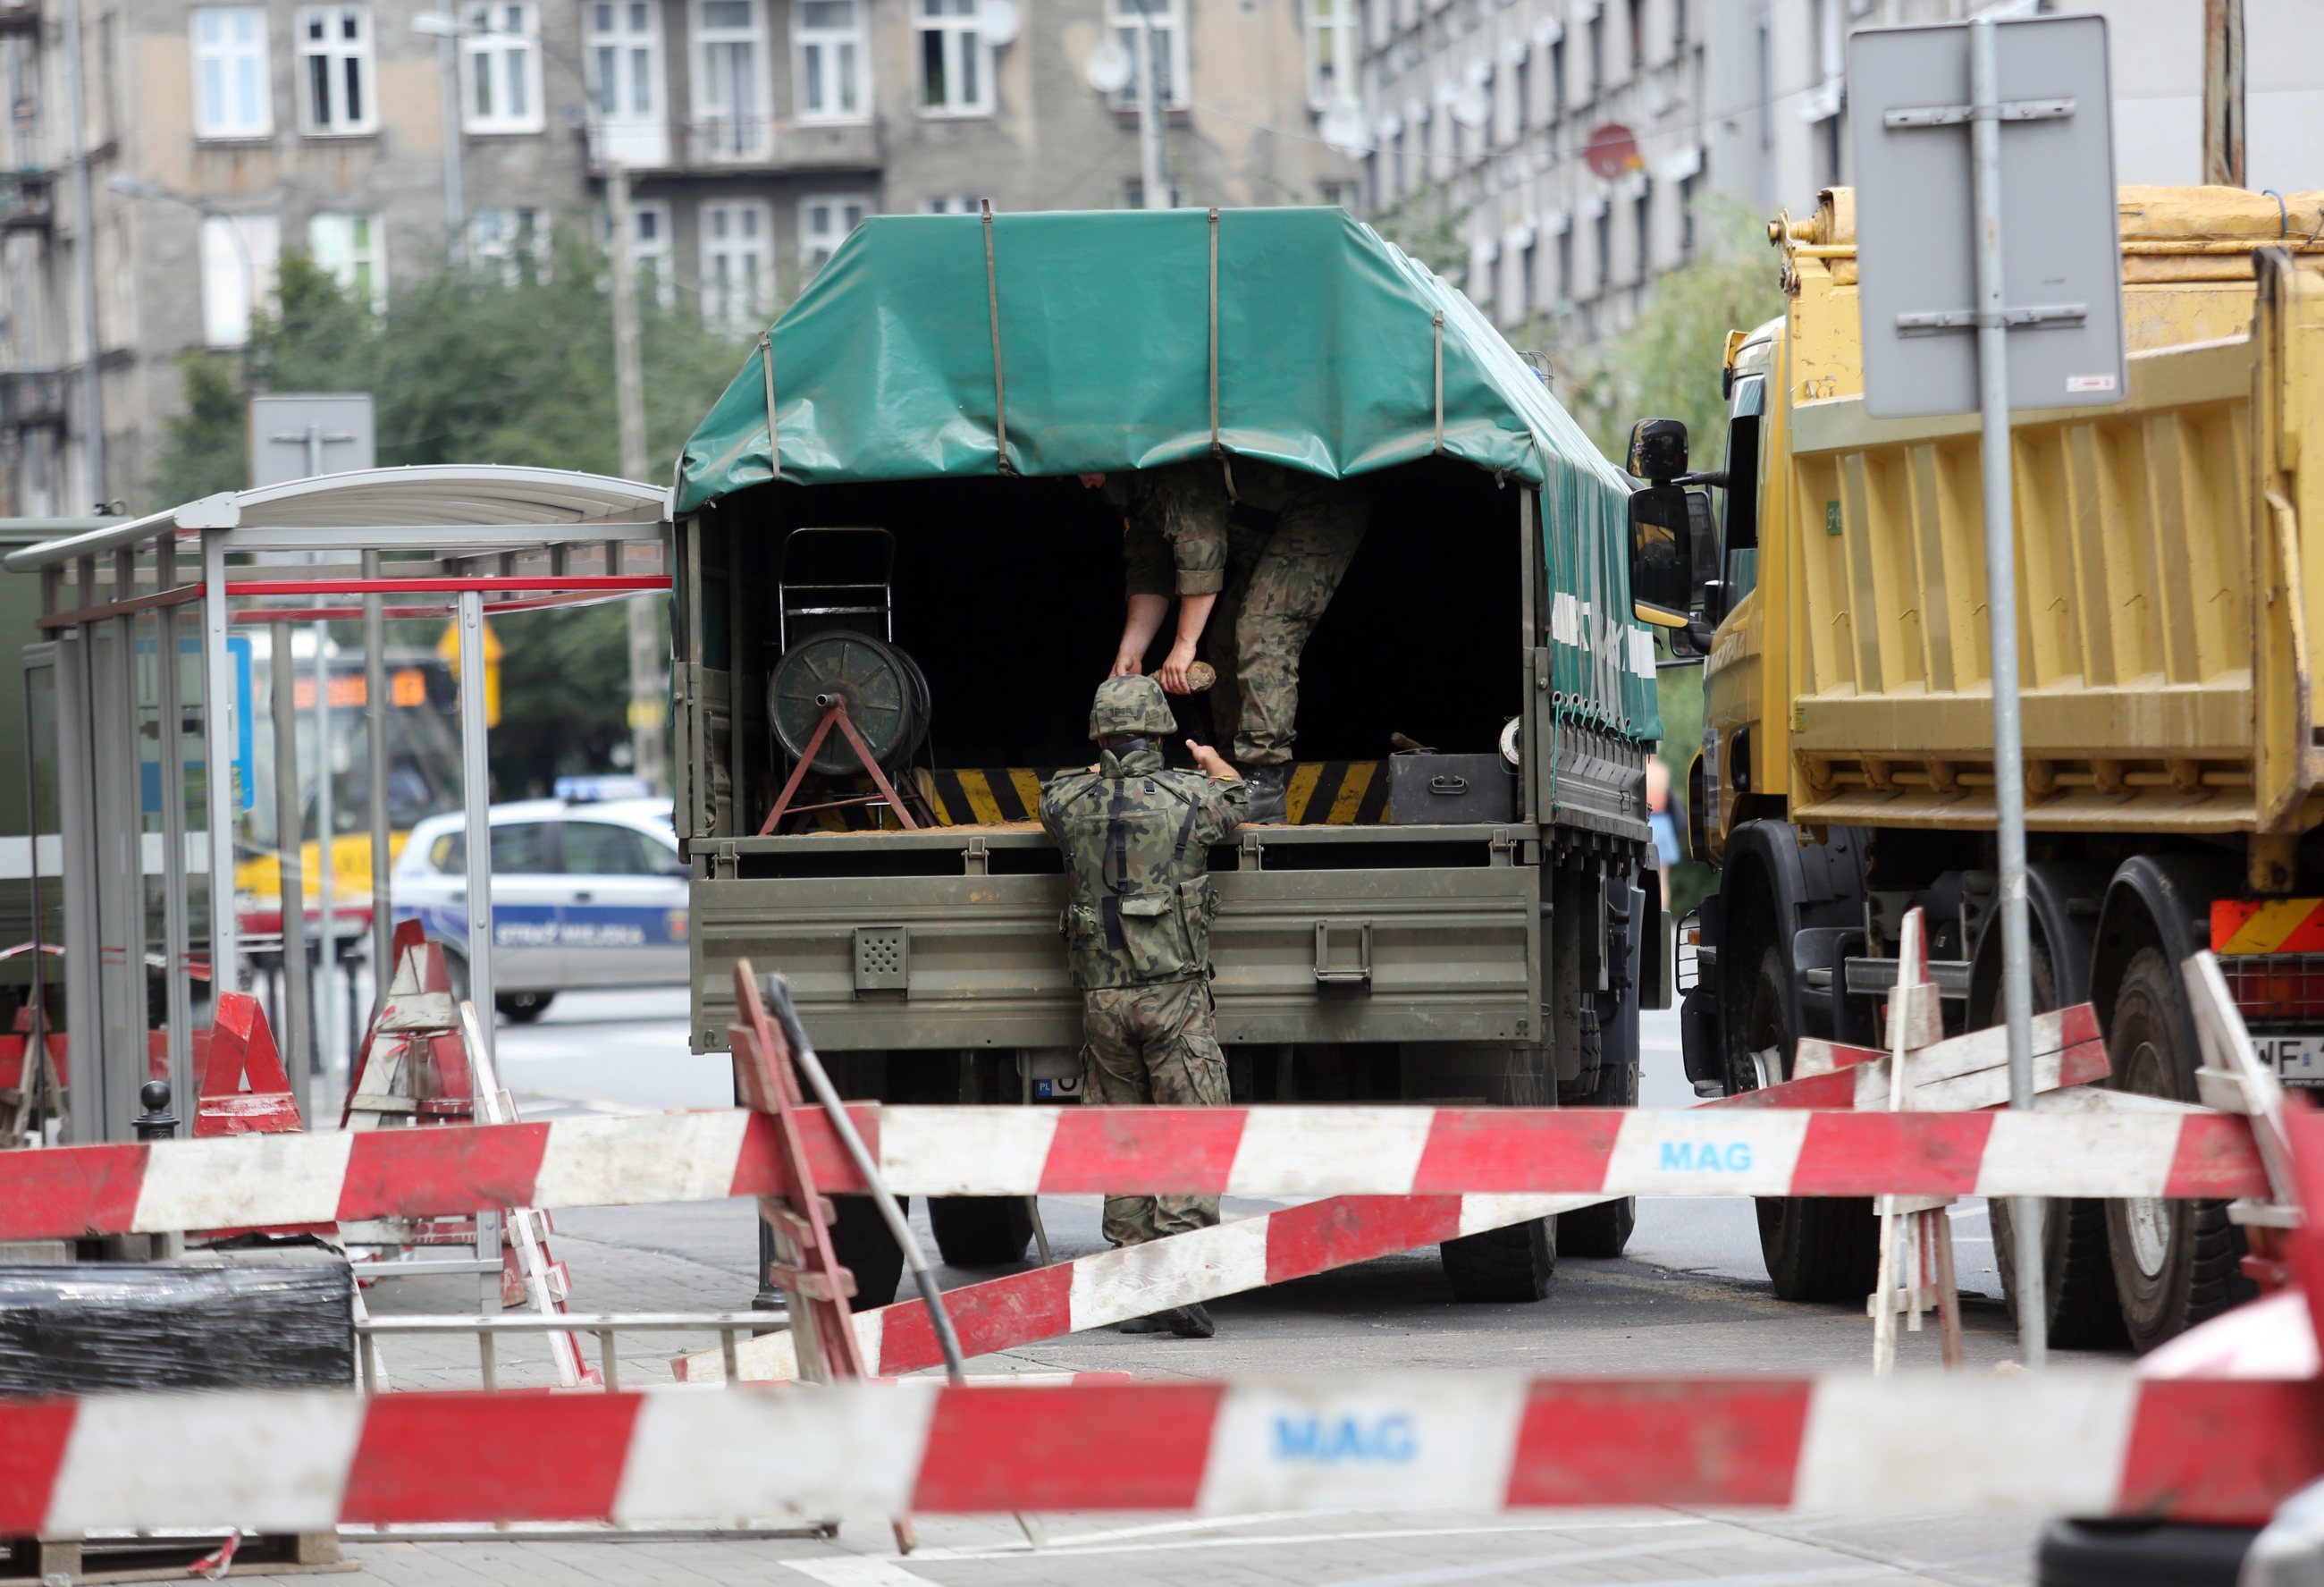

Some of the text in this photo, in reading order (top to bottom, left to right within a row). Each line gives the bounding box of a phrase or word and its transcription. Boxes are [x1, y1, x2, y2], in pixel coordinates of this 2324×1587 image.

[1040, 1083, 1050, 1091] PL
[1660, 1141, 1754, 1172] MAG
[1274, 1414, 1419, 1463] MAG
